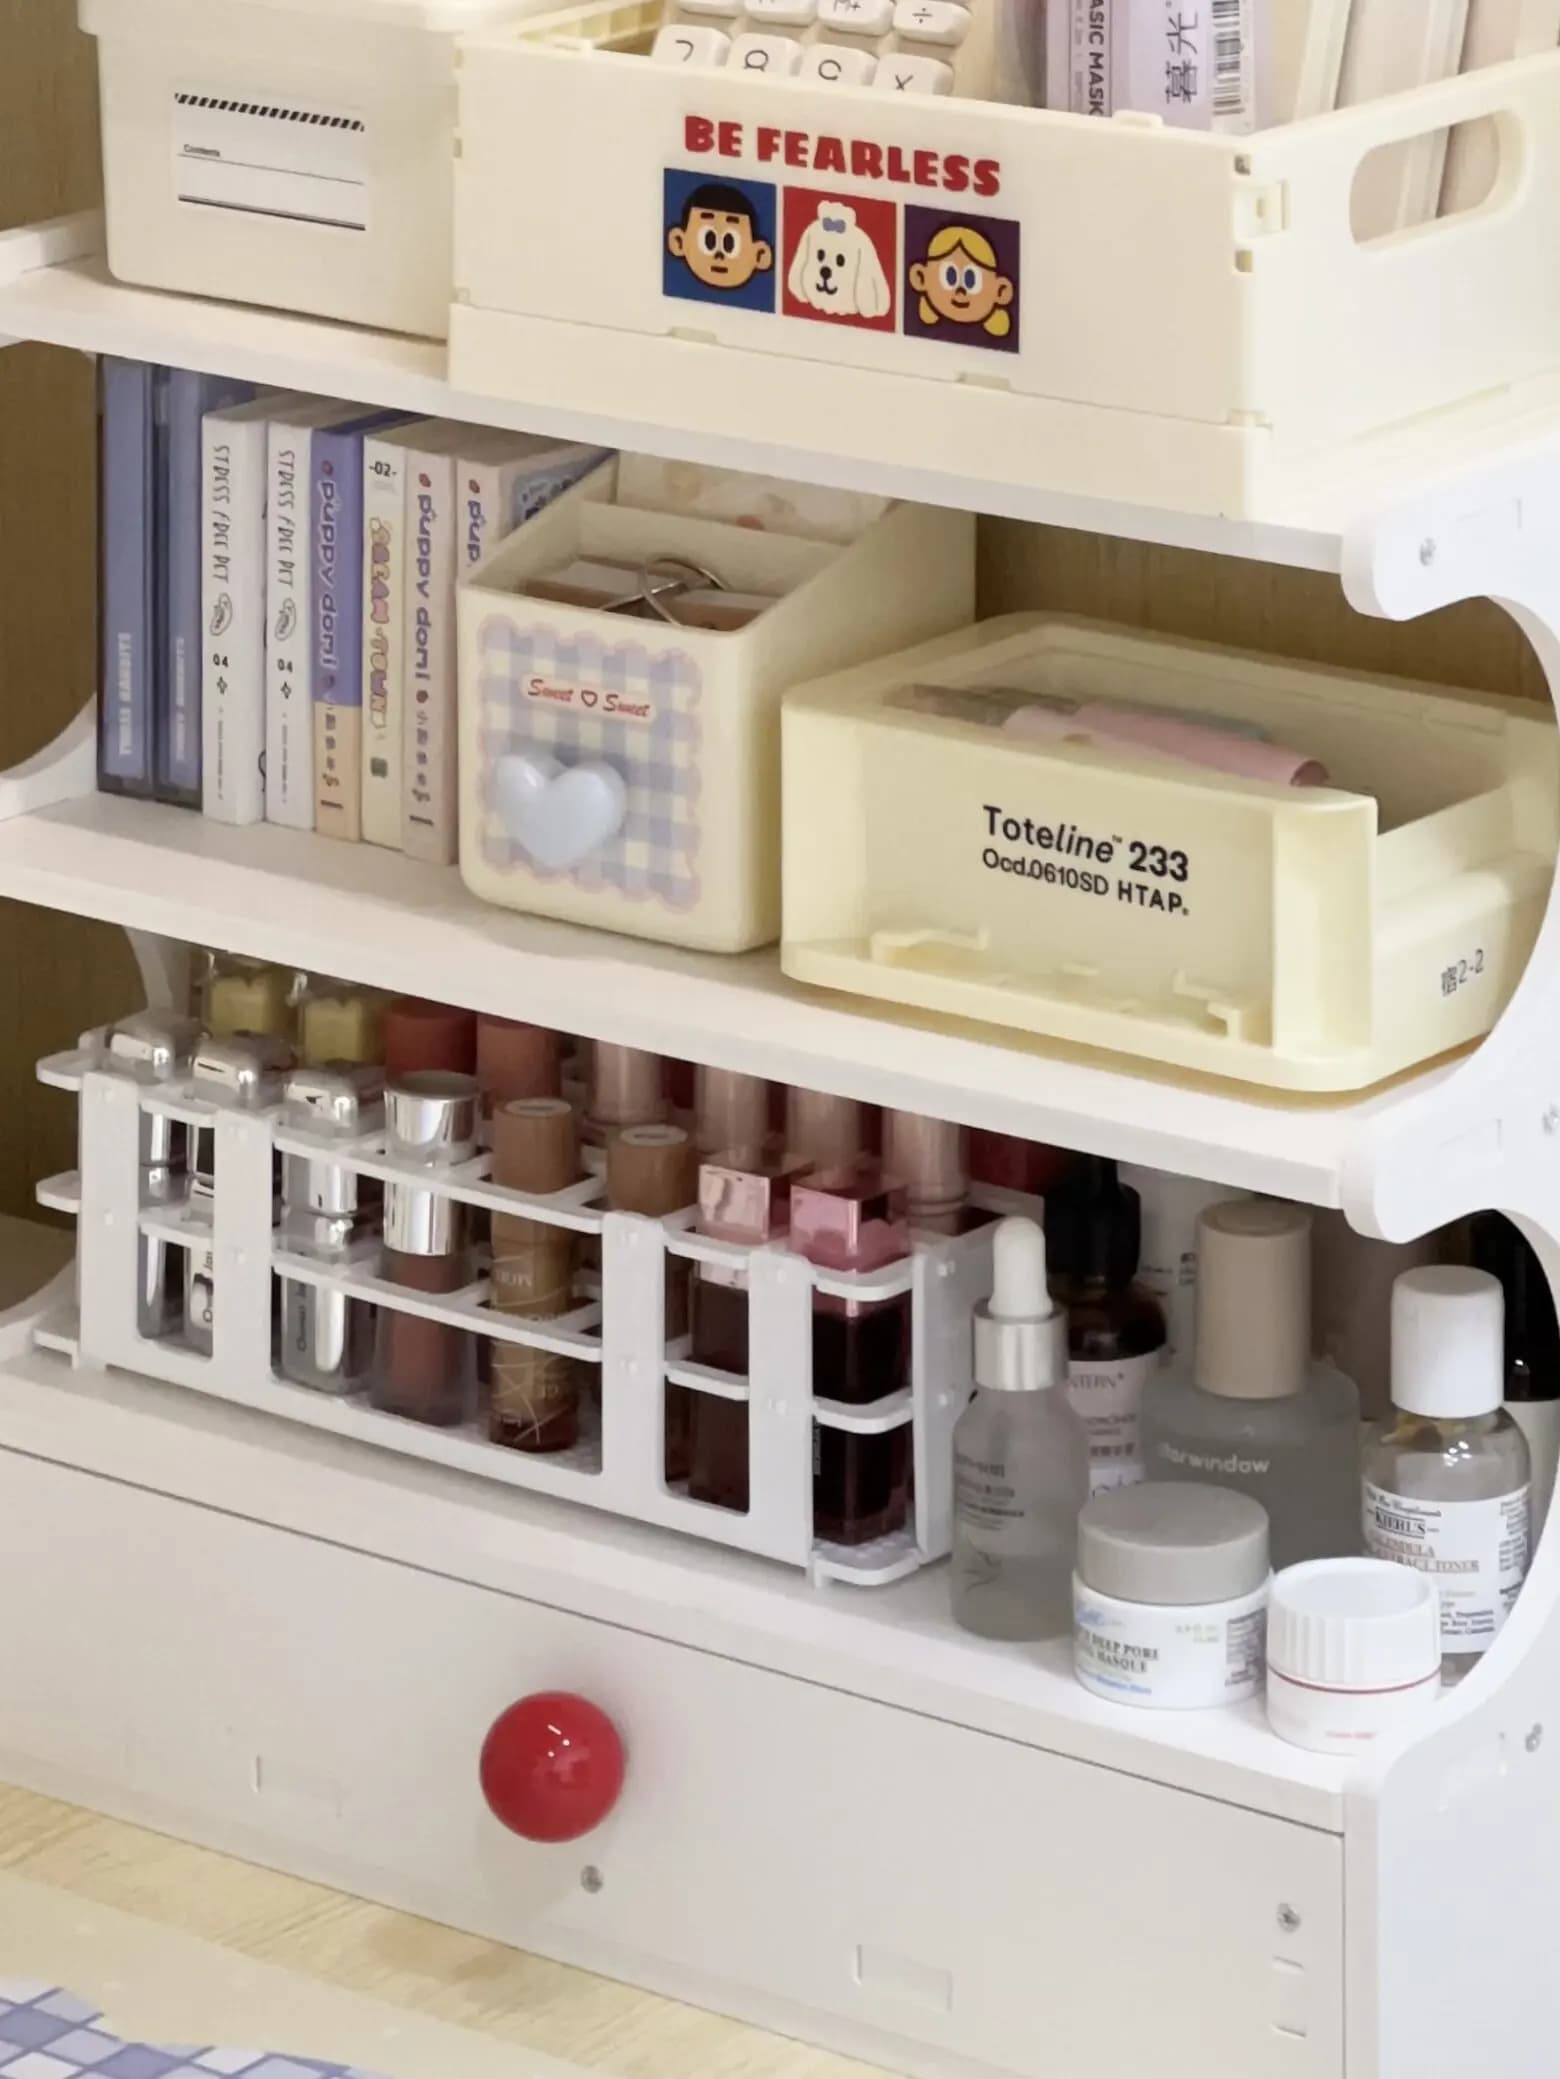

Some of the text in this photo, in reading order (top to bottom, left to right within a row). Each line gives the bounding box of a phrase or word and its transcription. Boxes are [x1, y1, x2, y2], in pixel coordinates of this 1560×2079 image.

[1088, 52, 1105, 116] MASK
[685, 115, 1001, 197] BE FEARLESS
[318, 480, 340, 589] puppy
[415, 494, 436, 599] puppy
[467, 500, 485, 568] pup
[1129, 840, 1189, 882] 233
